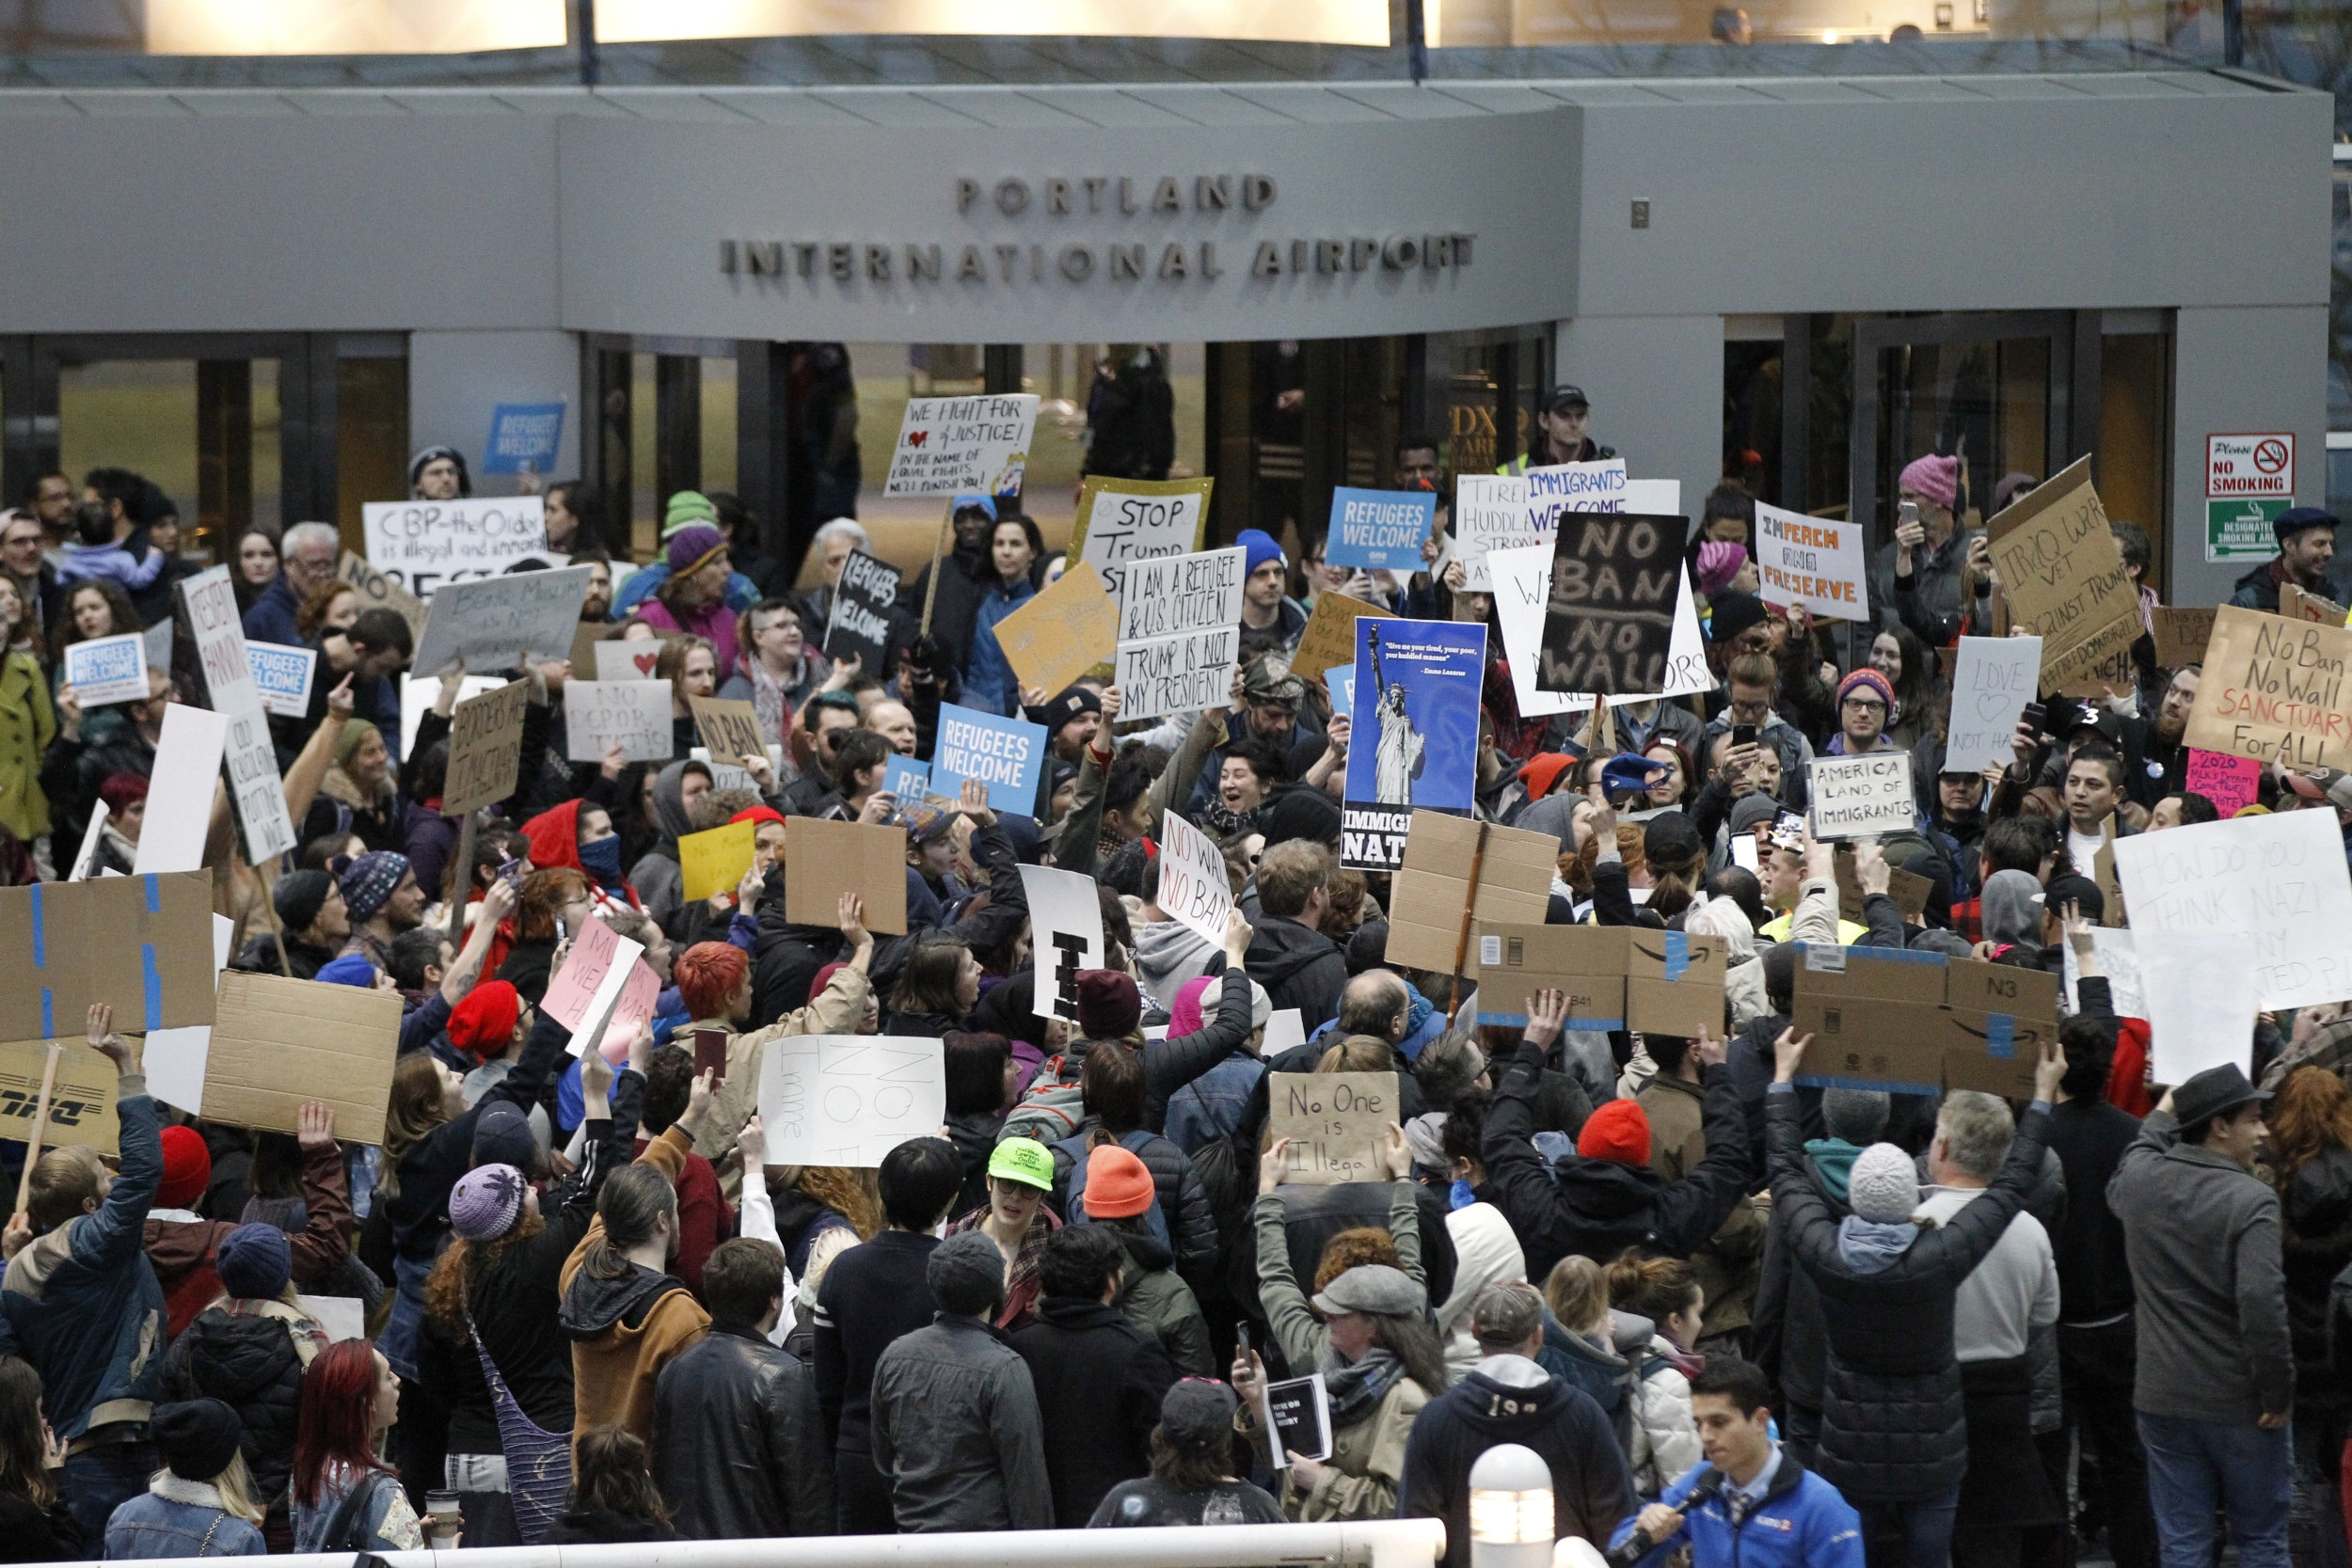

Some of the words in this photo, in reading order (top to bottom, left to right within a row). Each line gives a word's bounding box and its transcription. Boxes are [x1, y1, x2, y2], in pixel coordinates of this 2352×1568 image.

[956, 175, 1278, 216] PORTLAND
[719, 238, 1224, 283] INTERNATIONAL
[1251, 233, 1477, 277] AIRPORT
[910, 401, 932, 421] WE
[938, 399, 988, 421] FIGHT
[989, 398, 1022, 419] FOR
[951, 423, 1025, 447] JUSTICE!
[914, 453, 930, 466] THE
[932, 451, 961, 465] NAME
[965, 449, 983, 461] OF
[931, 465, 973, 477] RIGHTS
[2213, 461, 2233, 475] NO
[961, 470, 985, 491] YOU!
[1528, 469, 1627, 498] IMMIGRANTS
[2213, 477, 2284, 492] SMOKING
[482, 508, 539, 537] Order
[1118, 499, 1184, 528] STOP
[1344, 500, 1424, 527] REFUGEES
[1093, 531, 1183, 559] Trump
[1343, 524, 1421, 549] WELCOME
[1579, 520, 1659, 559] NO
[1763, 515, 1839, 550] IMPEACH
[2217, 532, 2256, 544] SMOKING
[2259, 533, 2278, 544] ARE
[382, 543, 397, 559] is
[404, 537, 453, 562] illegal
[459, 539, 487, 556] and
[1131, 568, 1138, 602] I
[1144, 565, 1164, 599] AM
[1171, 563, 1181, 594] A
[1185, 555, 1236, 593] REFUGEE
[1551, 556, 1673, 602] BAN
[2041, 550, 2073, 586] VET
[1764, 565, 1858, 603] PRESERVE
[2081, 562, 2129, 605] TRUMP
[834, 594, 891, 646] WELCOME
[1144, 595, 1168, 638] U.S.
[1172, 589, 1227, 631] CITIZEN
[1411, 643, 1426, 652] your
[1426, 643, 1443, 654] tired,
[1443, 645, 1459, 654] your
[1567, 617, 1642, 653] NO
[2254, 621, 2295, 660] No
[2296, 628, 2344, 677] Ban
[72, 645, 136, 668] REFUGEES
[248, 649, 307, 675] EFUGEES
[1125, 640, 1177, 681] TRUMP
[1185, 636, 1196, 673] IS
[1202, 631, 1231, 668] NOT
[1385, 652, 1398, 660] your
[1398, 652, 1422, 660] huddled
[74, 660, 138, 683] WELCOME
[252, 666, 304, 693] ELCOME
[1540, 649, 1664, 695] WALL
[1972, 658, 2026, 691] LOVE
[2243, 657, 2280, 694] No
[2284, 667, 2342, 709] Wall
[596, 686, 639, 706] NO
[1124, 679, 1150, 719] MY
[1153, 666, 1229, 714] PRESIDENT
[2081, 707, 2100, 724] 3
[697, 712, 726, 753] NO
[720, 713, 765, 758] BAN
[945, 719, 1030, 762] REFUGEES
[1953, 732, 1987, 748] NOT
[2233, 724, 2275, 754] For
[2277, 731, 2330, 768] ALL
[942, 745, 1025, 789] WELCOME
[1817, 760, 1899, 784] AMERICA
[2200, 753, 2237, 768] 2020
[1824, 783, 1872, 800] LAND
[1883, 780, 1904, 794] OF
[1817, 800, 1913, 825] IMMIGRANTS
[1167, 816, 1192, 862] NO
[2134, 847, 2203, 889] HOW
[2211, 845, 2245, 878] DO
[2260, 841, 2307, 868] YOU
[1161, 863, 1188, 911] NO
[1189, 879, 1230, 934] BAN
[2137, 887, 2232, 931] THINK
[2251, 879, 2324, 920] NAZI
[1986, 975, 2018, 999] N3
[1289, 1083, 1322, 1117] No
[1333, 1084, 1384, 1114] One
[1324, 1119, 1343, 1136] is
[1290, 1140, 1379, 1181] Illegal
